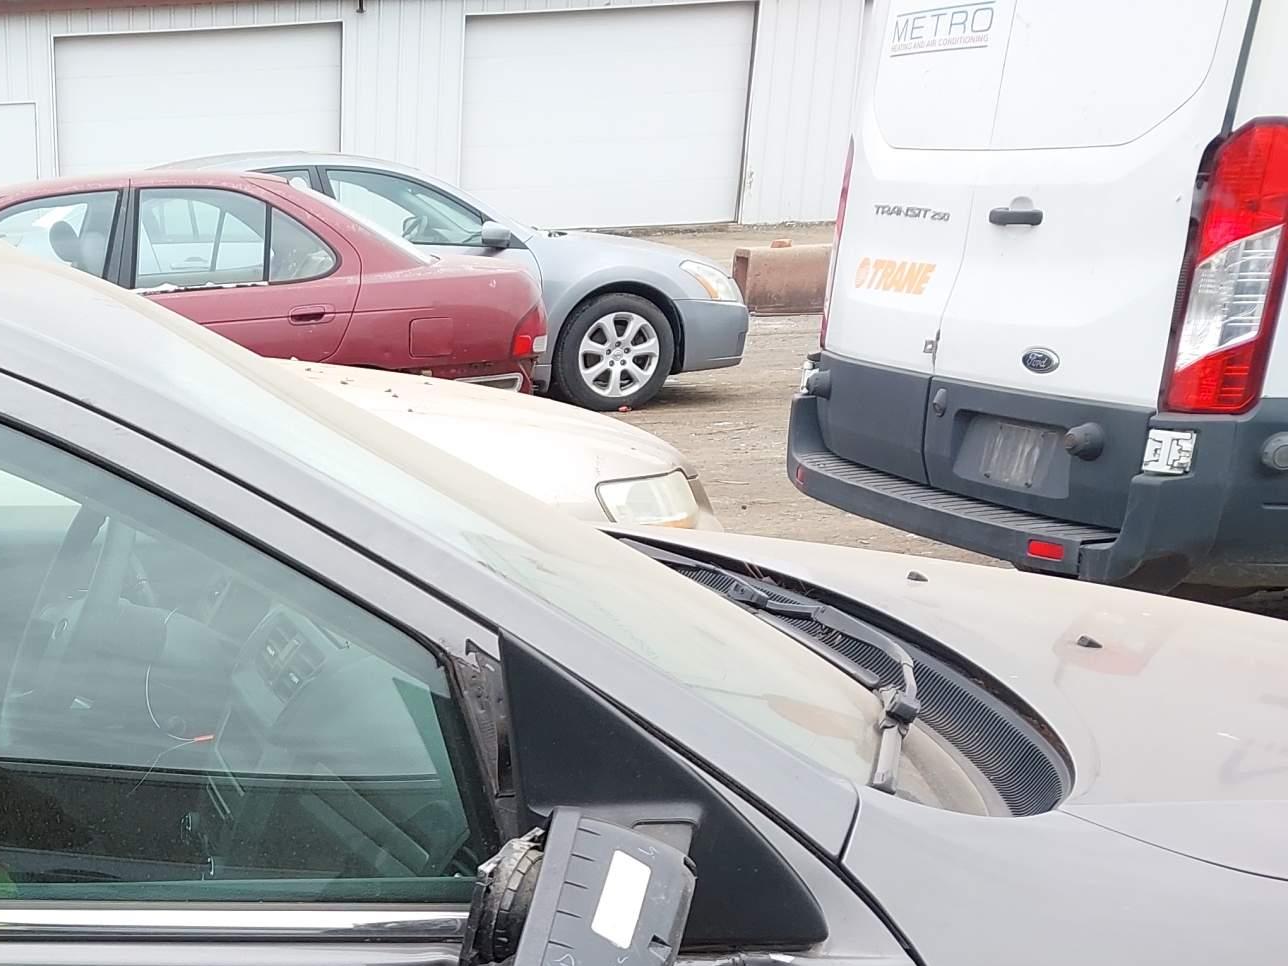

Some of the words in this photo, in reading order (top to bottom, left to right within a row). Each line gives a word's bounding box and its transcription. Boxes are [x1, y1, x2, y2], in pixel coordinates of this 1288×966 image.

[892, 7, 994, 43] METRO
[926, 39, 937, 48] AIR
[938, 34, 989, 47] CONDITIONING
[874, 204, 931, 219] TRANSIT
[930, 211, 951, 221] 250
[867, 259, 937, 295] TRANE
